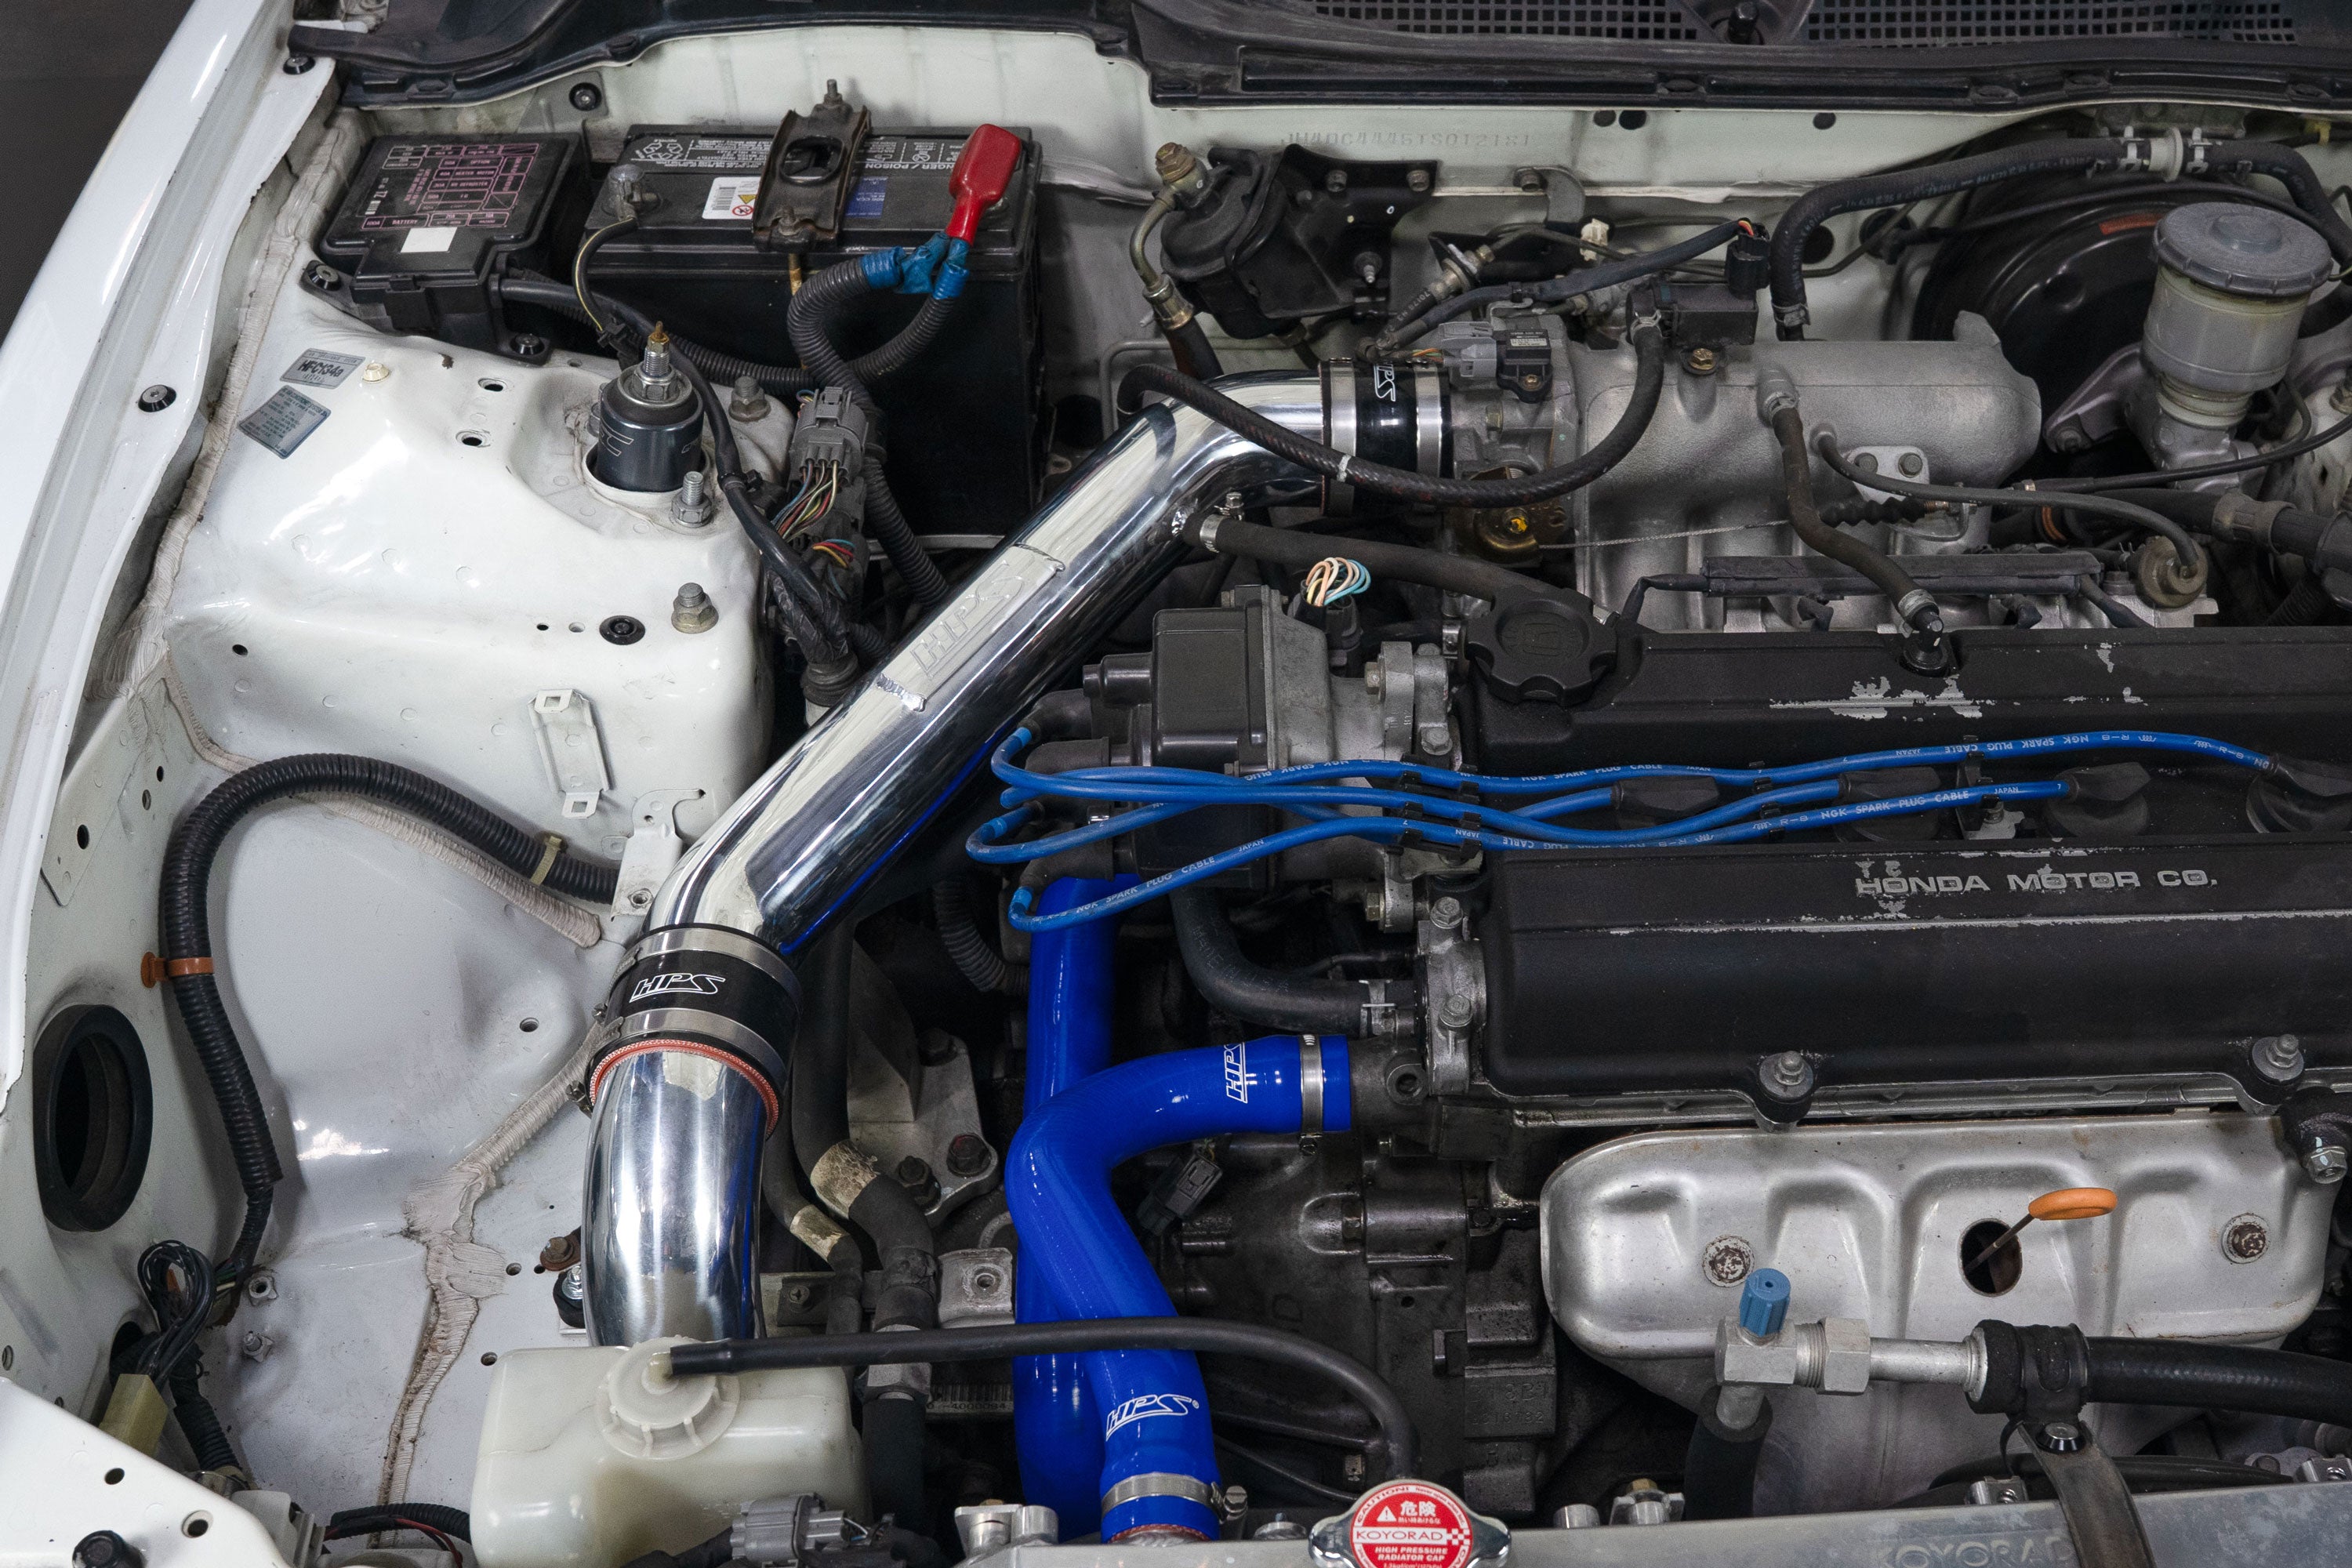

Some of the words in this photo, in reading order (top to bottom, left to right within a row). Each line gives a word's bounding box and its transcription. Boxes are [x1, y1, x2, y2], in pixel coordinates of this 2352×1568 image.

[298, 360, 344, 377] HFC134a
[1987, 742, 2013, 751] PLUG
[2022, 738, 2055, 748] SPARK
[2063, 735, 2089, 744] NGK
[1944, 744, 1978, 753] CABLE
[1281, 764, 1316, 774] SPARK
[1554, 771, 1587, 780] SPARK
[1595, 765, 1621, 774] PLUG
[1820, 808, 1847, 819] NGK
[1856, 801, 1891, 814] SPARK
[1899, 797, 1926, 808] PLUG
[1935, 790, 1969, 802] CABLE
[1994, 786, 2020, 795] JAPAN
[1455, 829, 1480, 839] JAPAN
[1502, 837, 1535, 849] CABLE
[1076, 900, 1098, 913] NGK
[1105, 887, 1138, 903] SPARK
[1145, 873, 1174, 887] PLUG
[1181, 856, 1216, 874] CABLE
[1239, 839, 1265, 852] JAPAN
[1856, 874, 1991, 895] HONDA
[2007, 871, 2141, 890] MOTOR
[2157, 869, 2218, 887] CO.
[630, 972, 726, 1004] HPS
[1105, 1393, 1193, 1442] HPS
[1357, 1486, 1410, 1523] CAUTION!
[1400, 1500, 1436, 1518] 危険
[1356, 1530, 1443, 1541] KOYORAD
